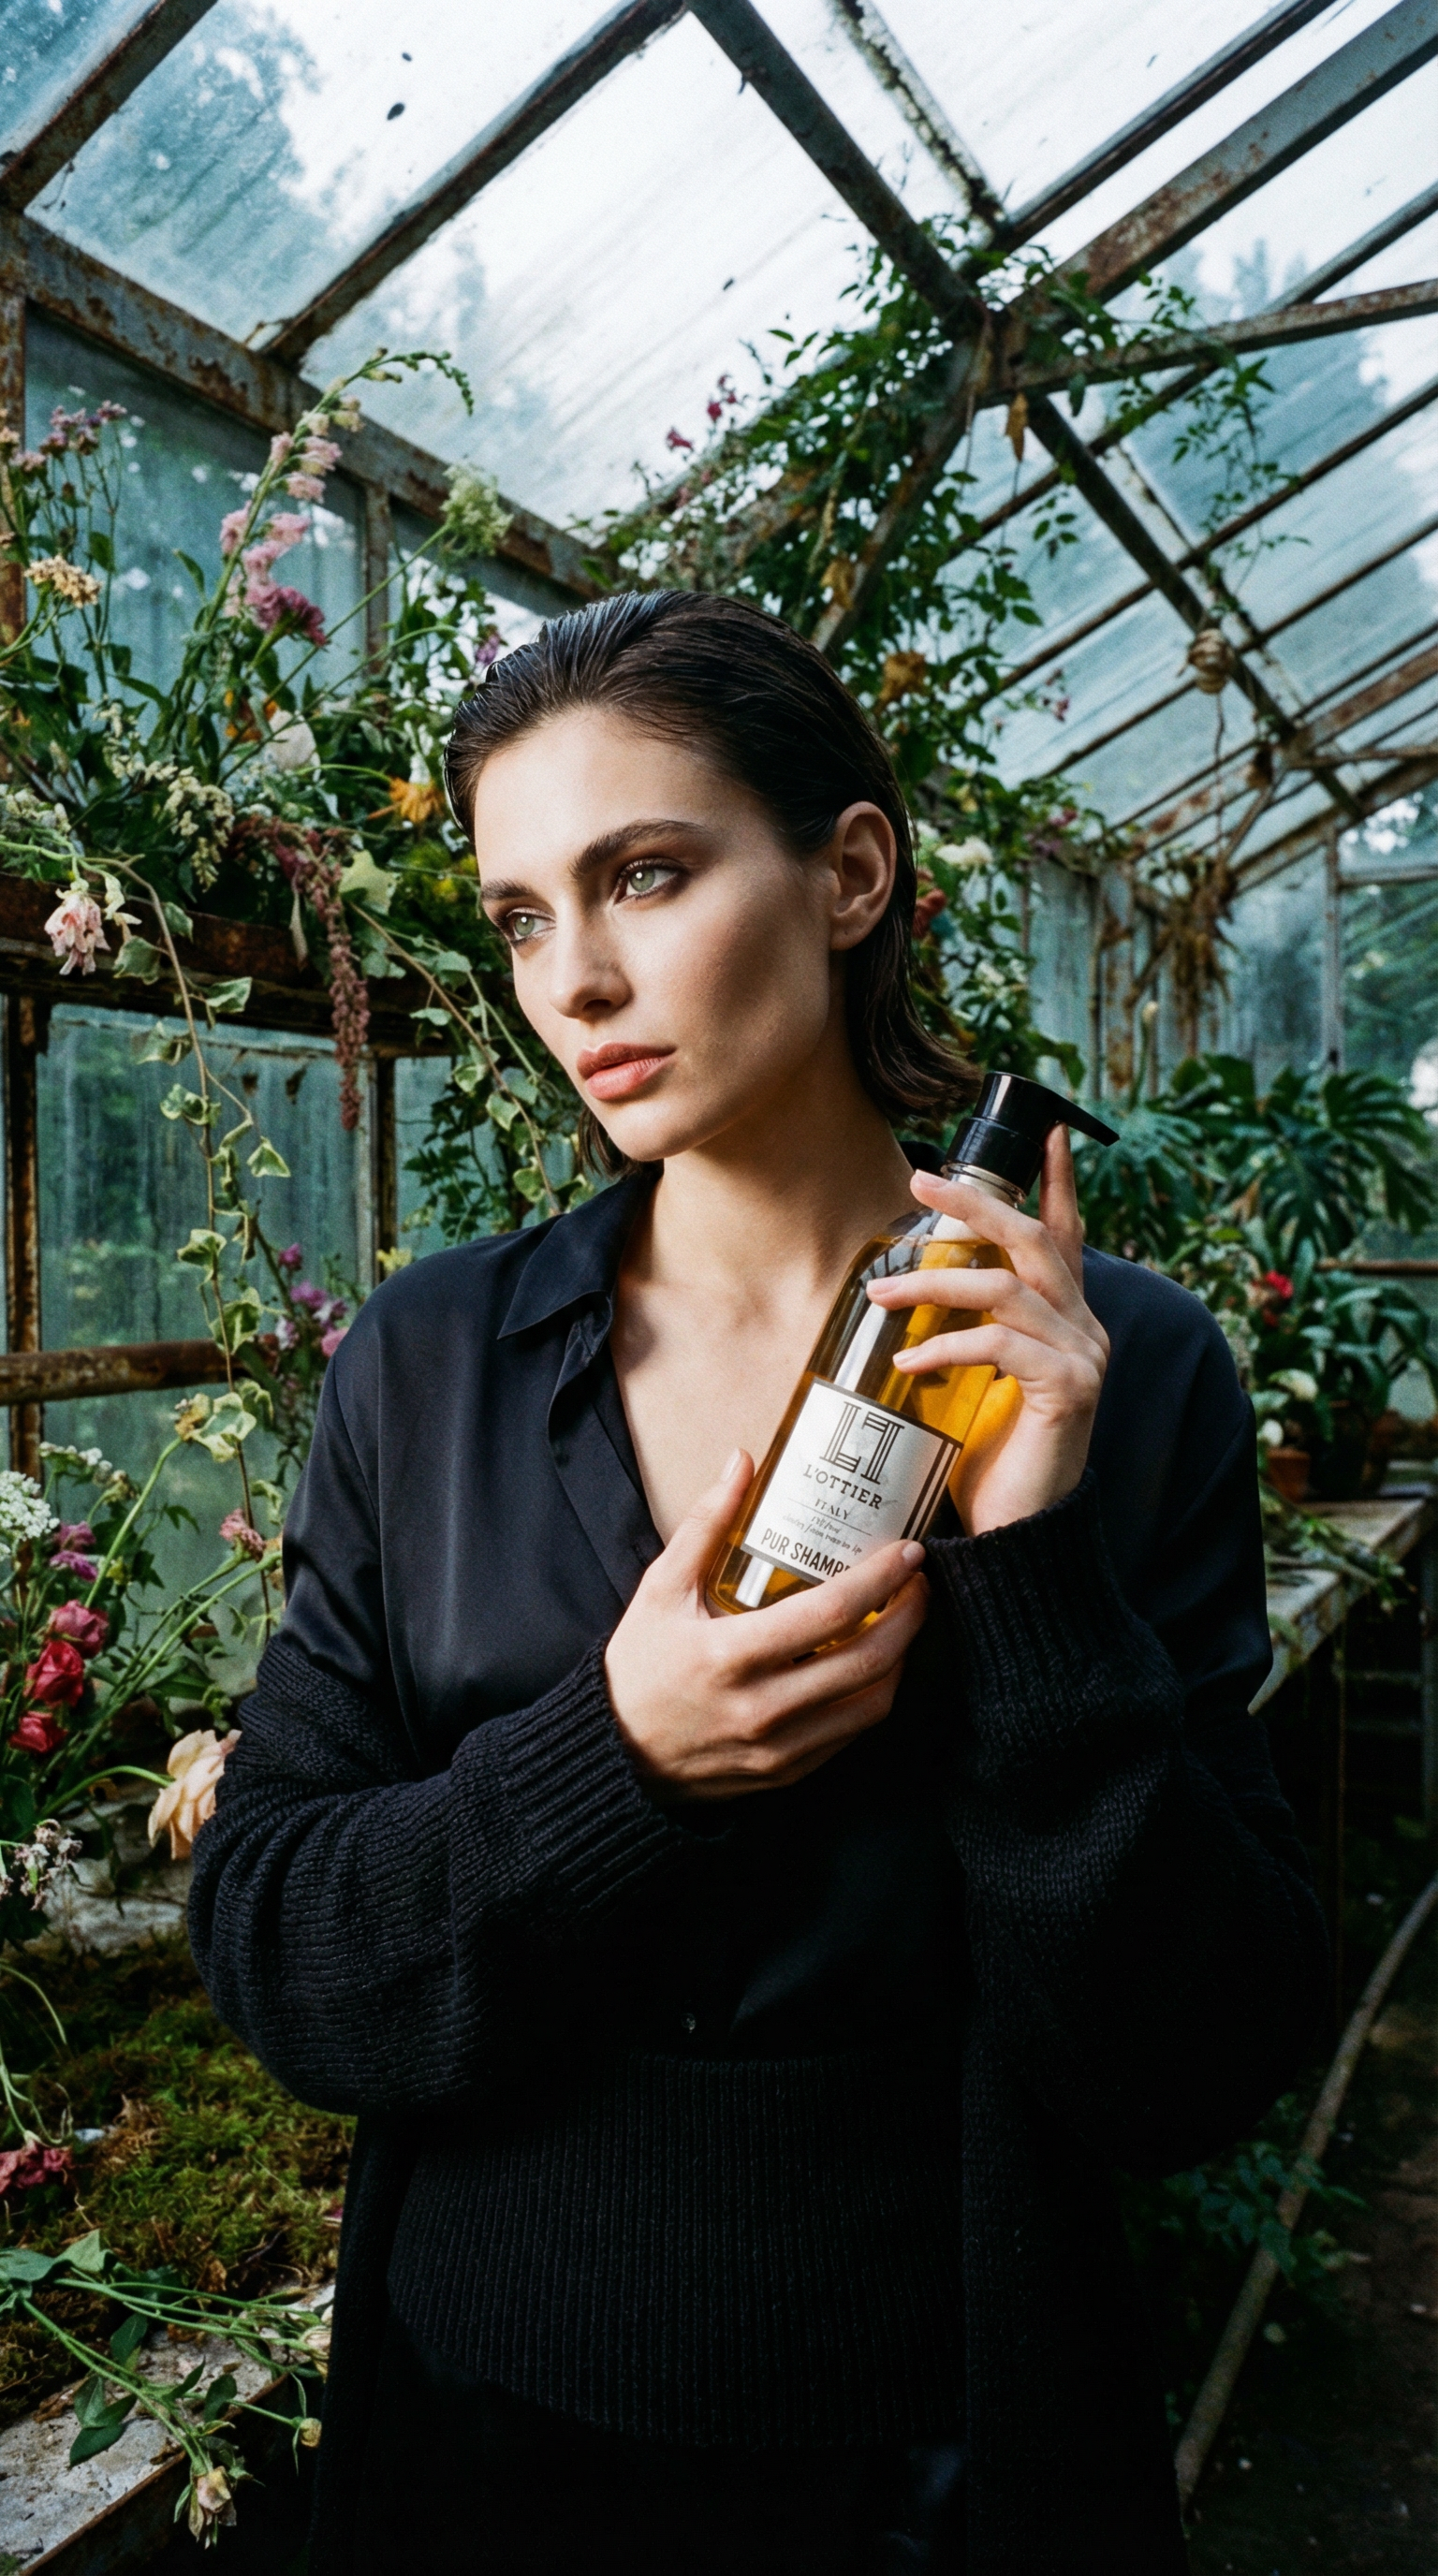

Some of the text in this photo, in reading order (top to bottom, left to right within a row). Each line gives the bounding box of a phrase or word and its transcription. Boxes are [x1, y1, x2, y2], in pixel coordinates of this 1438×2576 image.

[802, 1464, 883, 1510] L'OTTIER
[814, 1498, 850, 1520] ITALY
[760, 1528, 790, 1556] PUR
